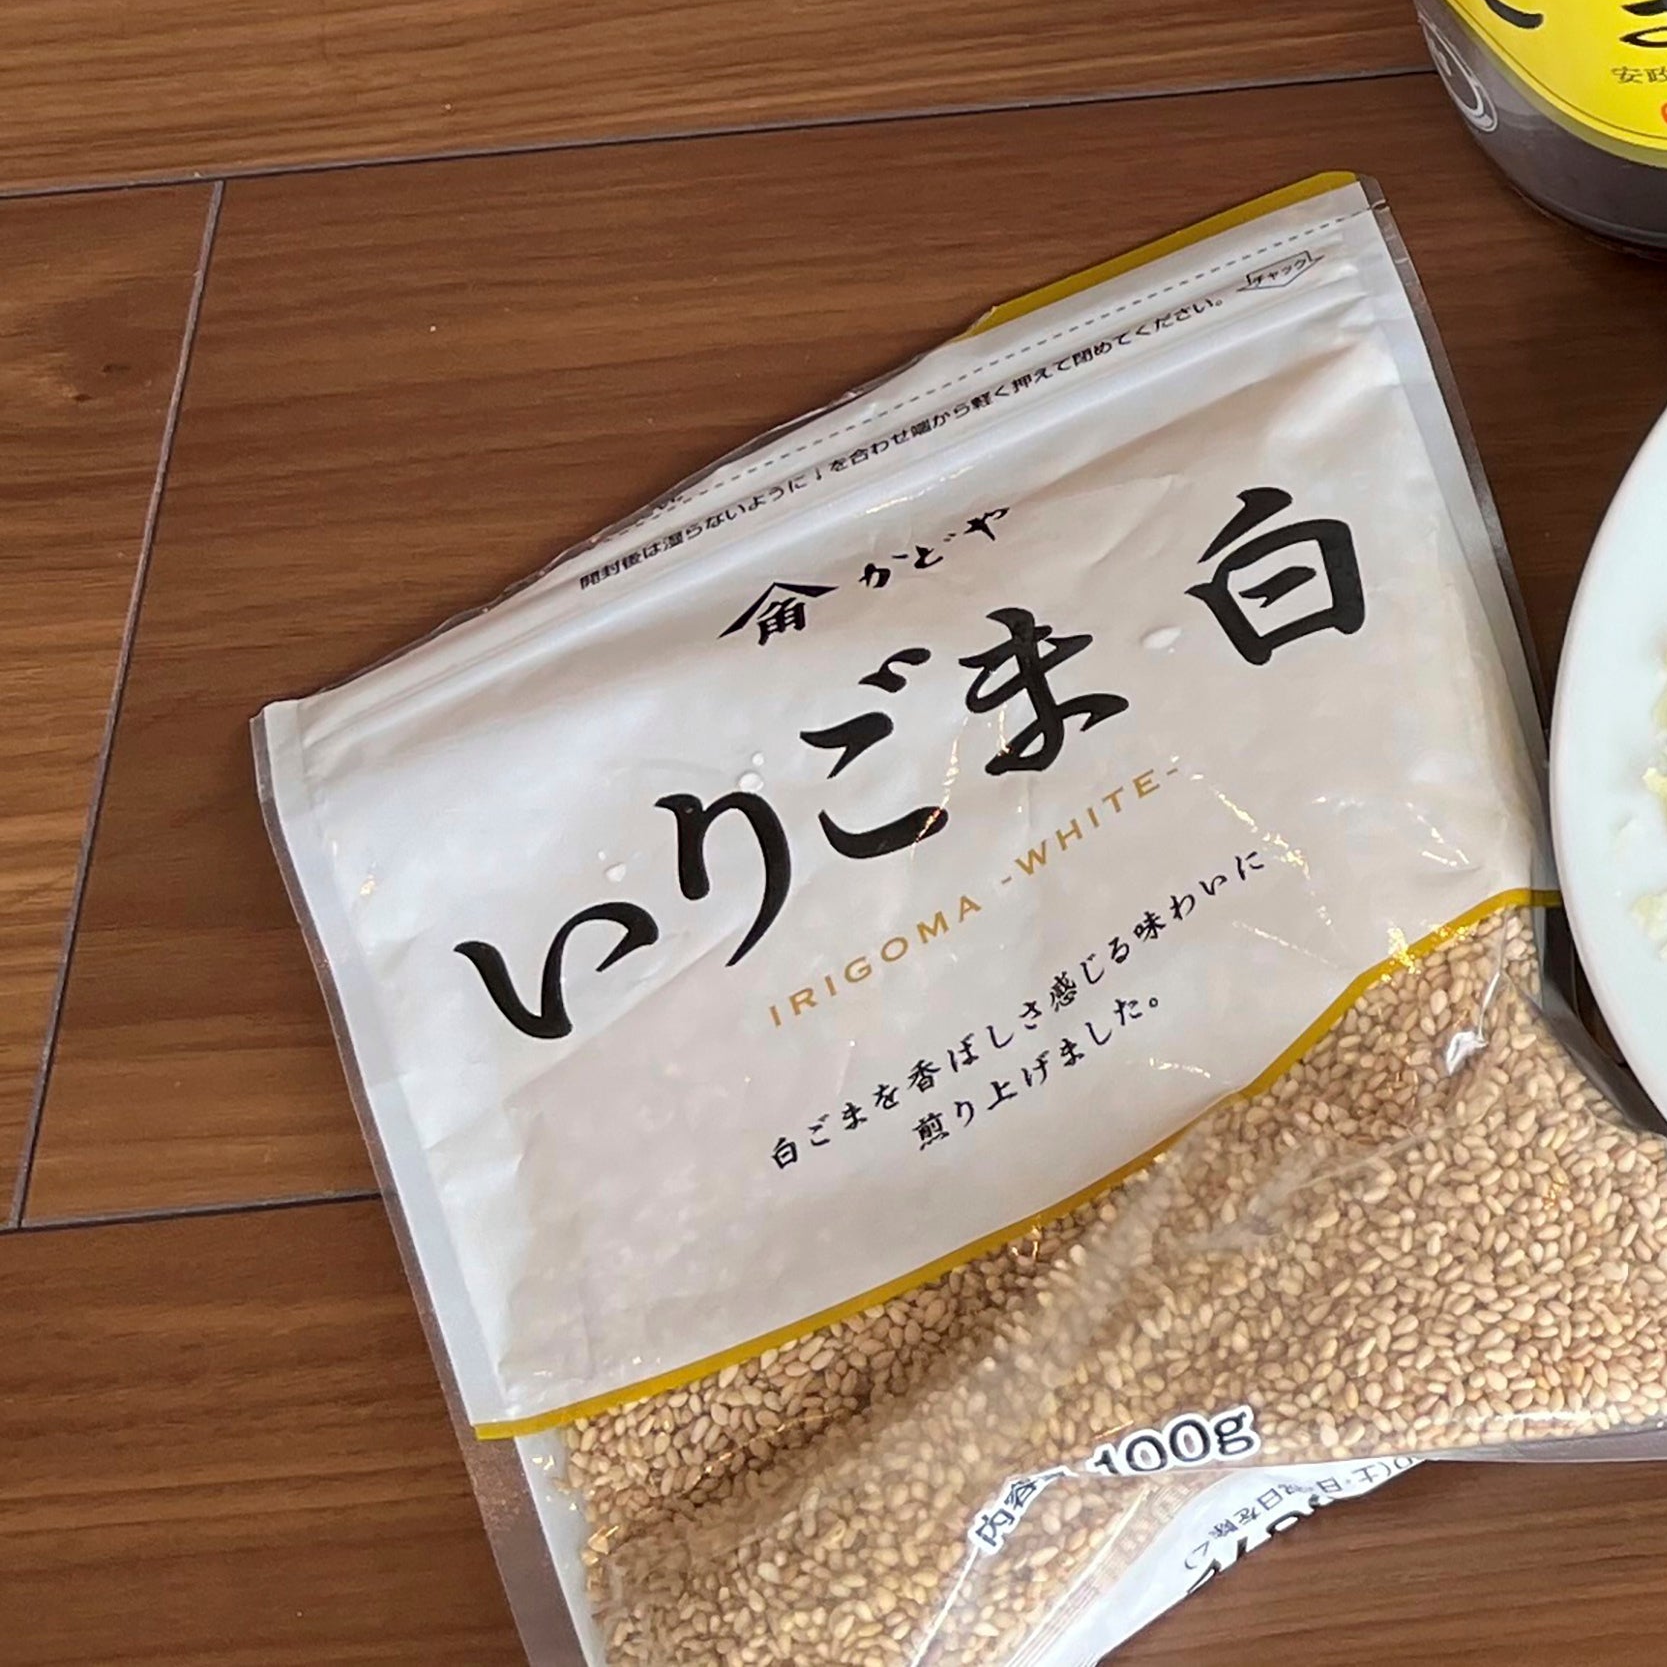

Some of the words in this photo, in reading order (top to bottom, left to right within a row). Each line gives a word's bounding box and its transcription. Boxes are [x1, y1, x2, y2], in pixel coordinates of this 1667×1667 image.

[858, 506, 1011, 590] かどや
[454, 607, 1130, 1040] いりごま
[1185, 485, 1367, 667] 白
[768, 893, 982, 1028] IRIGOMA
[771, 849, 1265, 1172] 白ごまを香ばしさ感じる味わいに
[913, 996, 1159, 1151] 煎り上げました。
